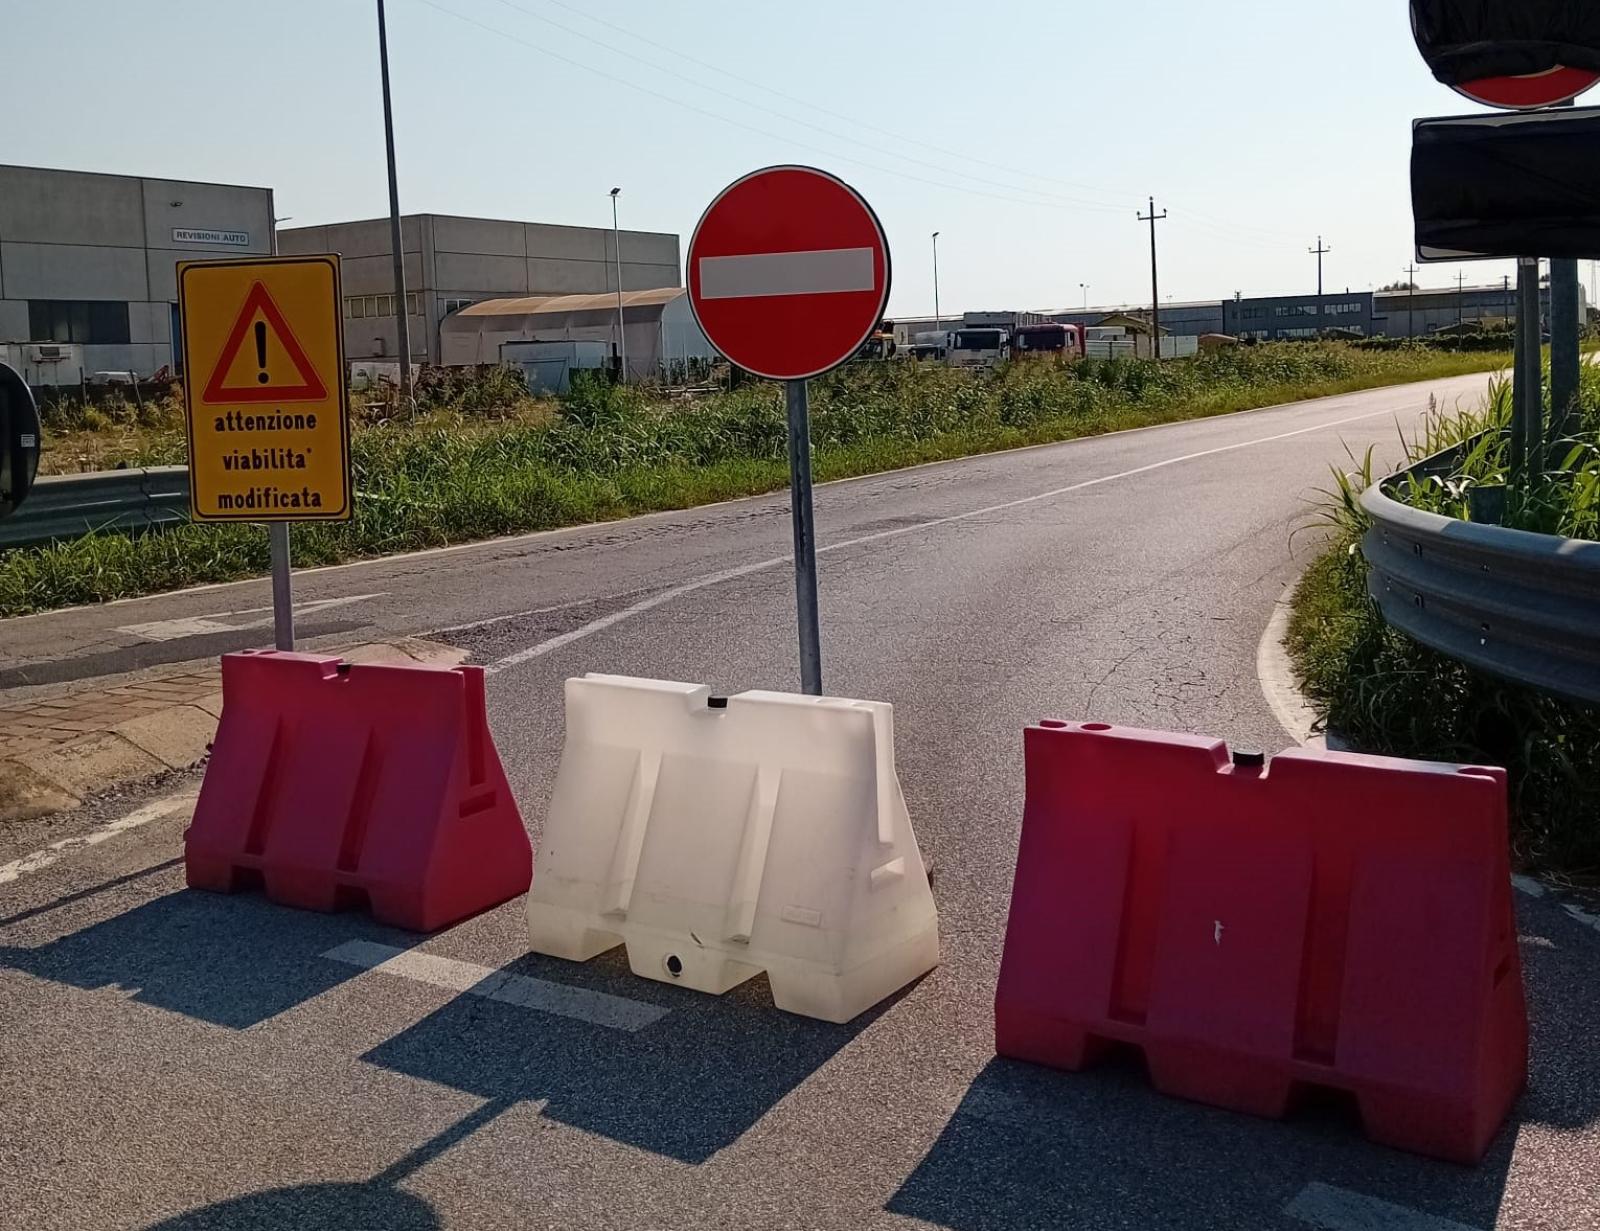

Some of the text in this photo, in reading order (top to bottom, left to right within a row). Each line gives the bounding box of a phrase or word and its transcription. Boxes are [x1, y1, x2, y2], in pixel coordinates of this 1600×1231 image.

[176, 231, 246, 242] REVISIONI AUTO
[214, 410, 317, 432] attenzione
[218, 487, 322, 509] modificata
